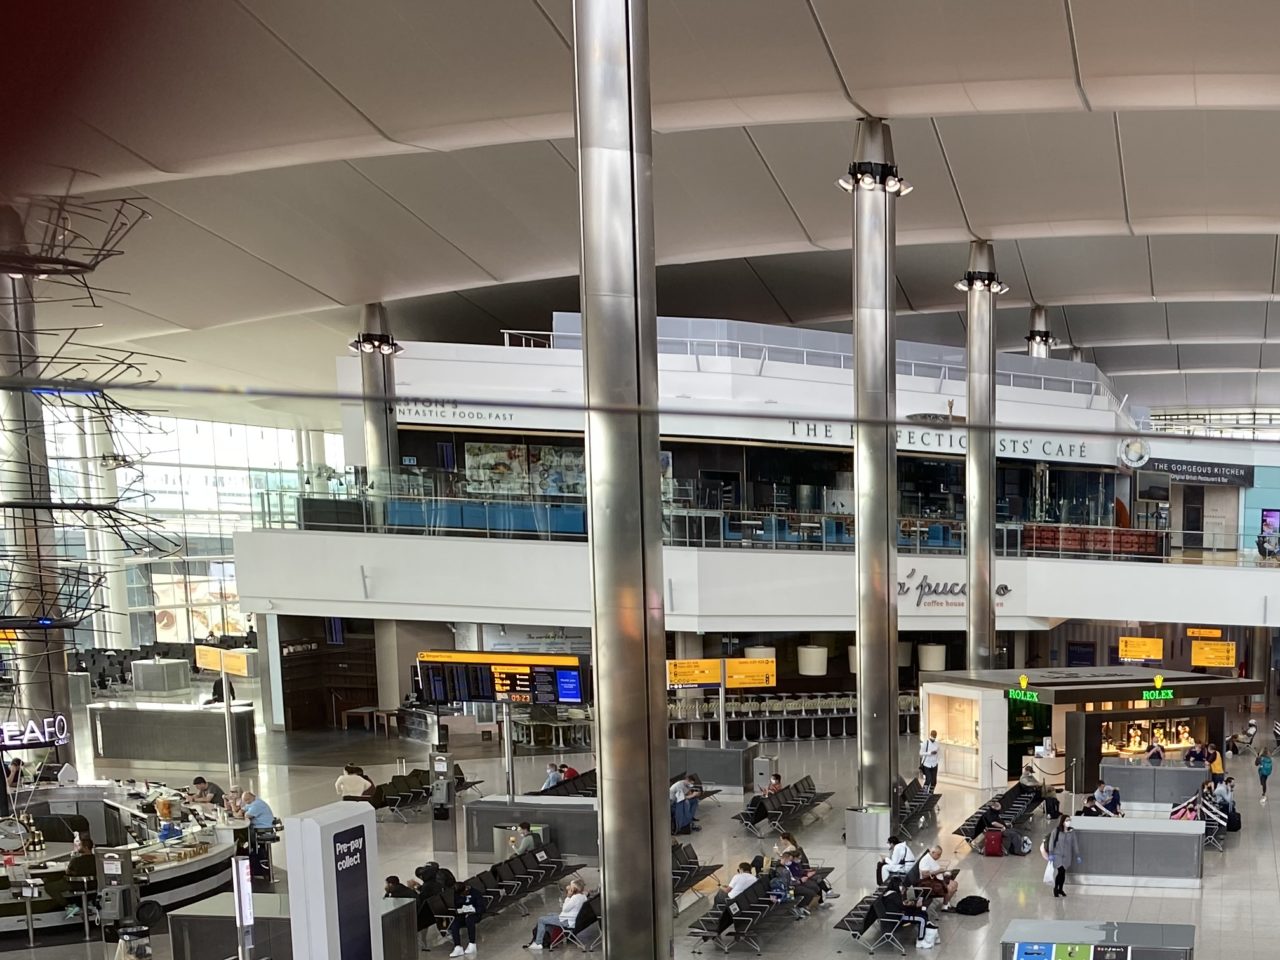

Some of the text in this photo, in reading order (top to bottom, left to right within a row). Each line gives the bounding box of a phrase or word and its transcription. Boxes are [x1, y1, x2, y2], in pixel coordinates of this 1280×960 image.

[398, 408, 446, 418] NTASTIC
[788, 420, 833, 438] THE
[1042, 441, 1088, 459] CAFÉ
[1154, 462, 1245, 477] THE GORGEOUS KITCHEN
[924, 600, 944, 608] coffee
[1009, 689, 1039, 702] ROLEX
[1142, 689, 1174, 700] ROLEX
[0, 715, 67, 746] EAFO
[336, 837, 363, 855] Pre-pay
[337, 852, 360, 871] collect
